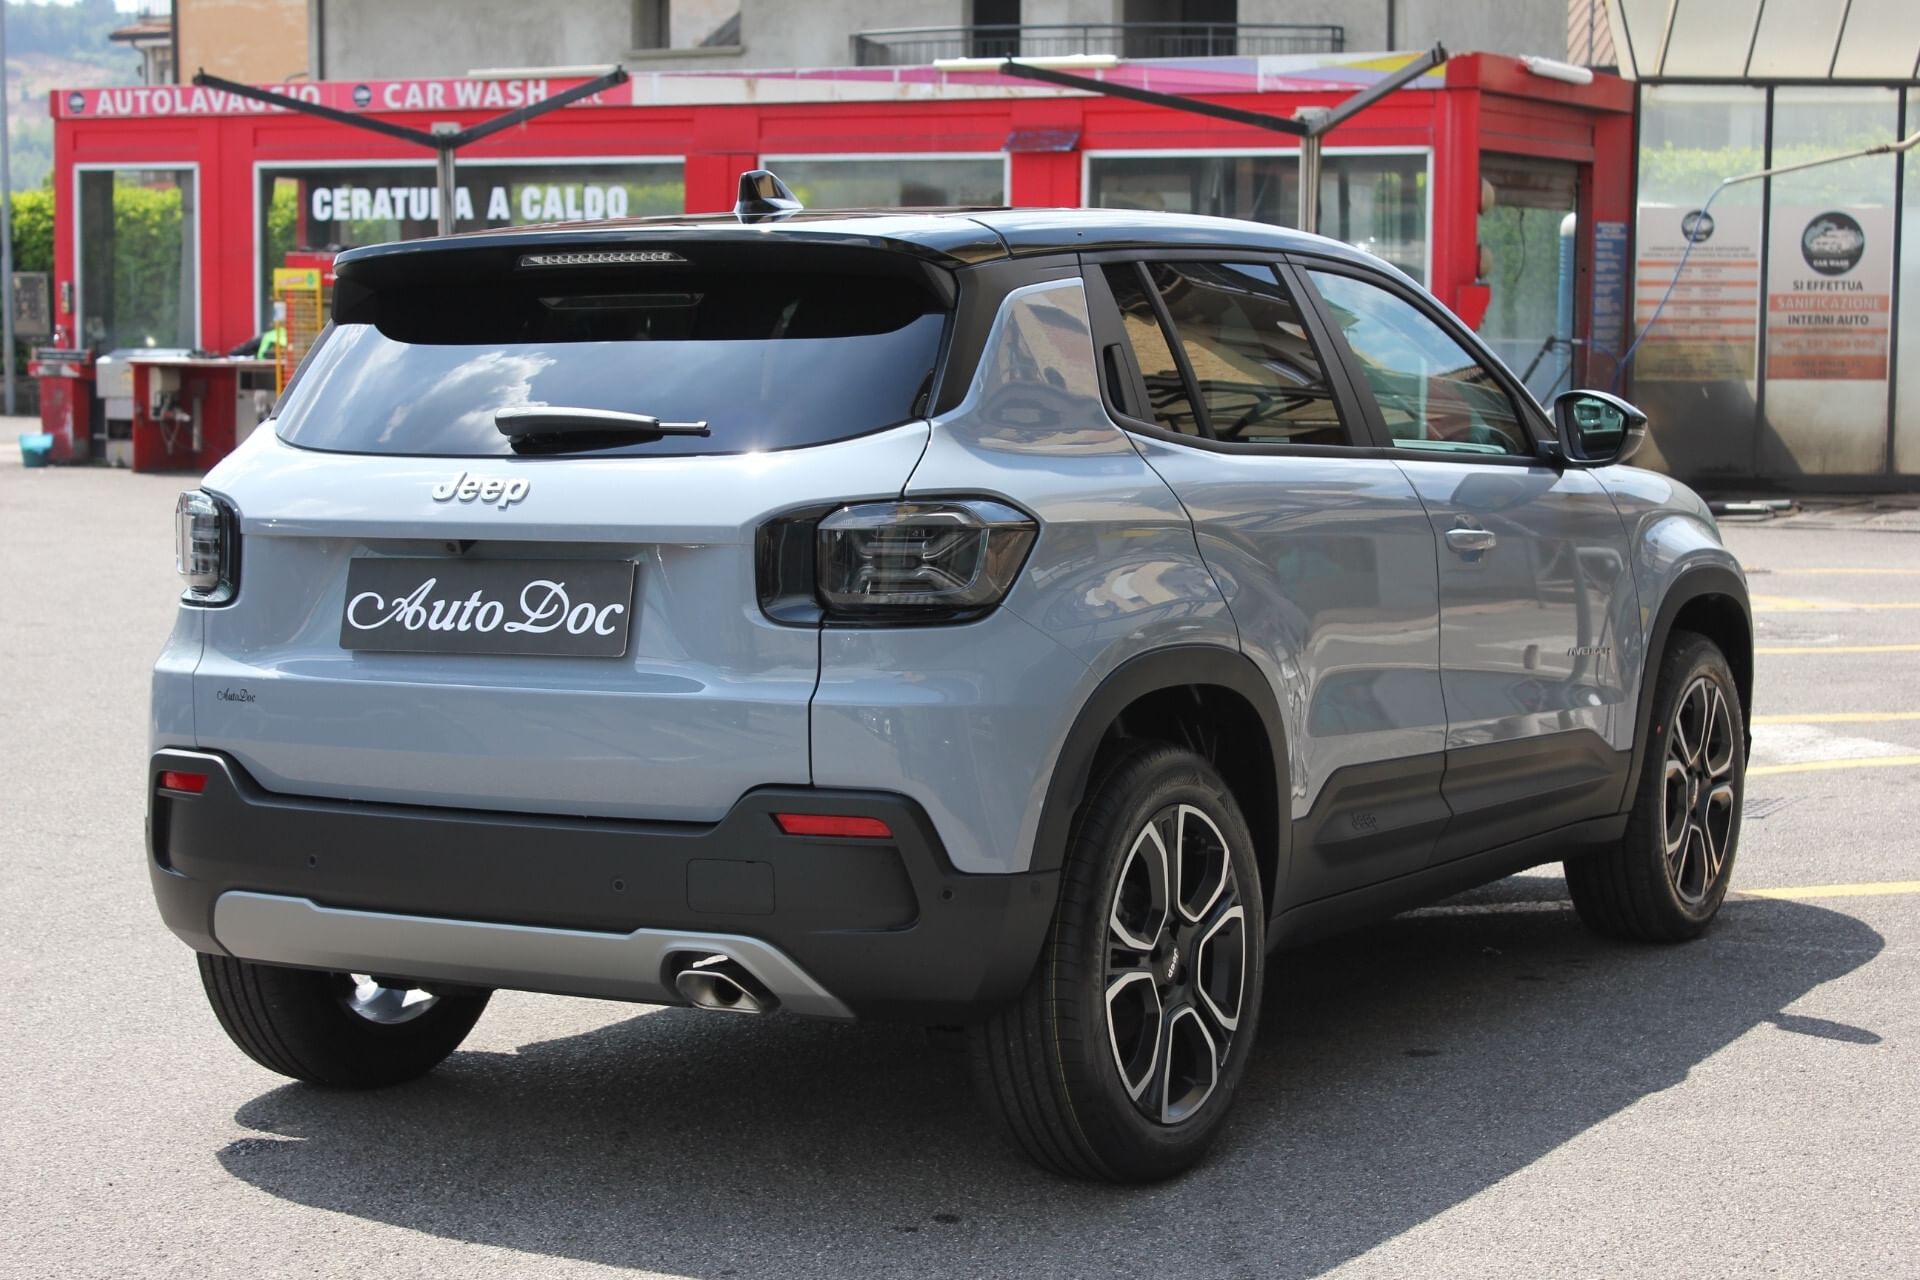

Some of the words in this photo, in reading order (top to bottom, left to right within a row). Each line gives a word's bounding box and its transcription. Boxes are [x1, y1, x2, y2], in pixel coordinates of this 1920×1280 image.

[383, 83, 445, 109] CAR
[454, 80, 548, 106] WASH
[312, 186, 474, 221] CERATUA
[487, 187, 511, 220] A
[520, 186, 628, 220] CALDO
[1793, 280, 1804, 291] SI
[1807, 280, 1863, 291] EFFETTUA
[1777, 298, 1880, 310] SANIFICAZIONE
[1788, 314, 1835, 325] INTERNI
[1837, 315, 1869, 325] AUTO
[432, 472, 530, 511] Jeep
